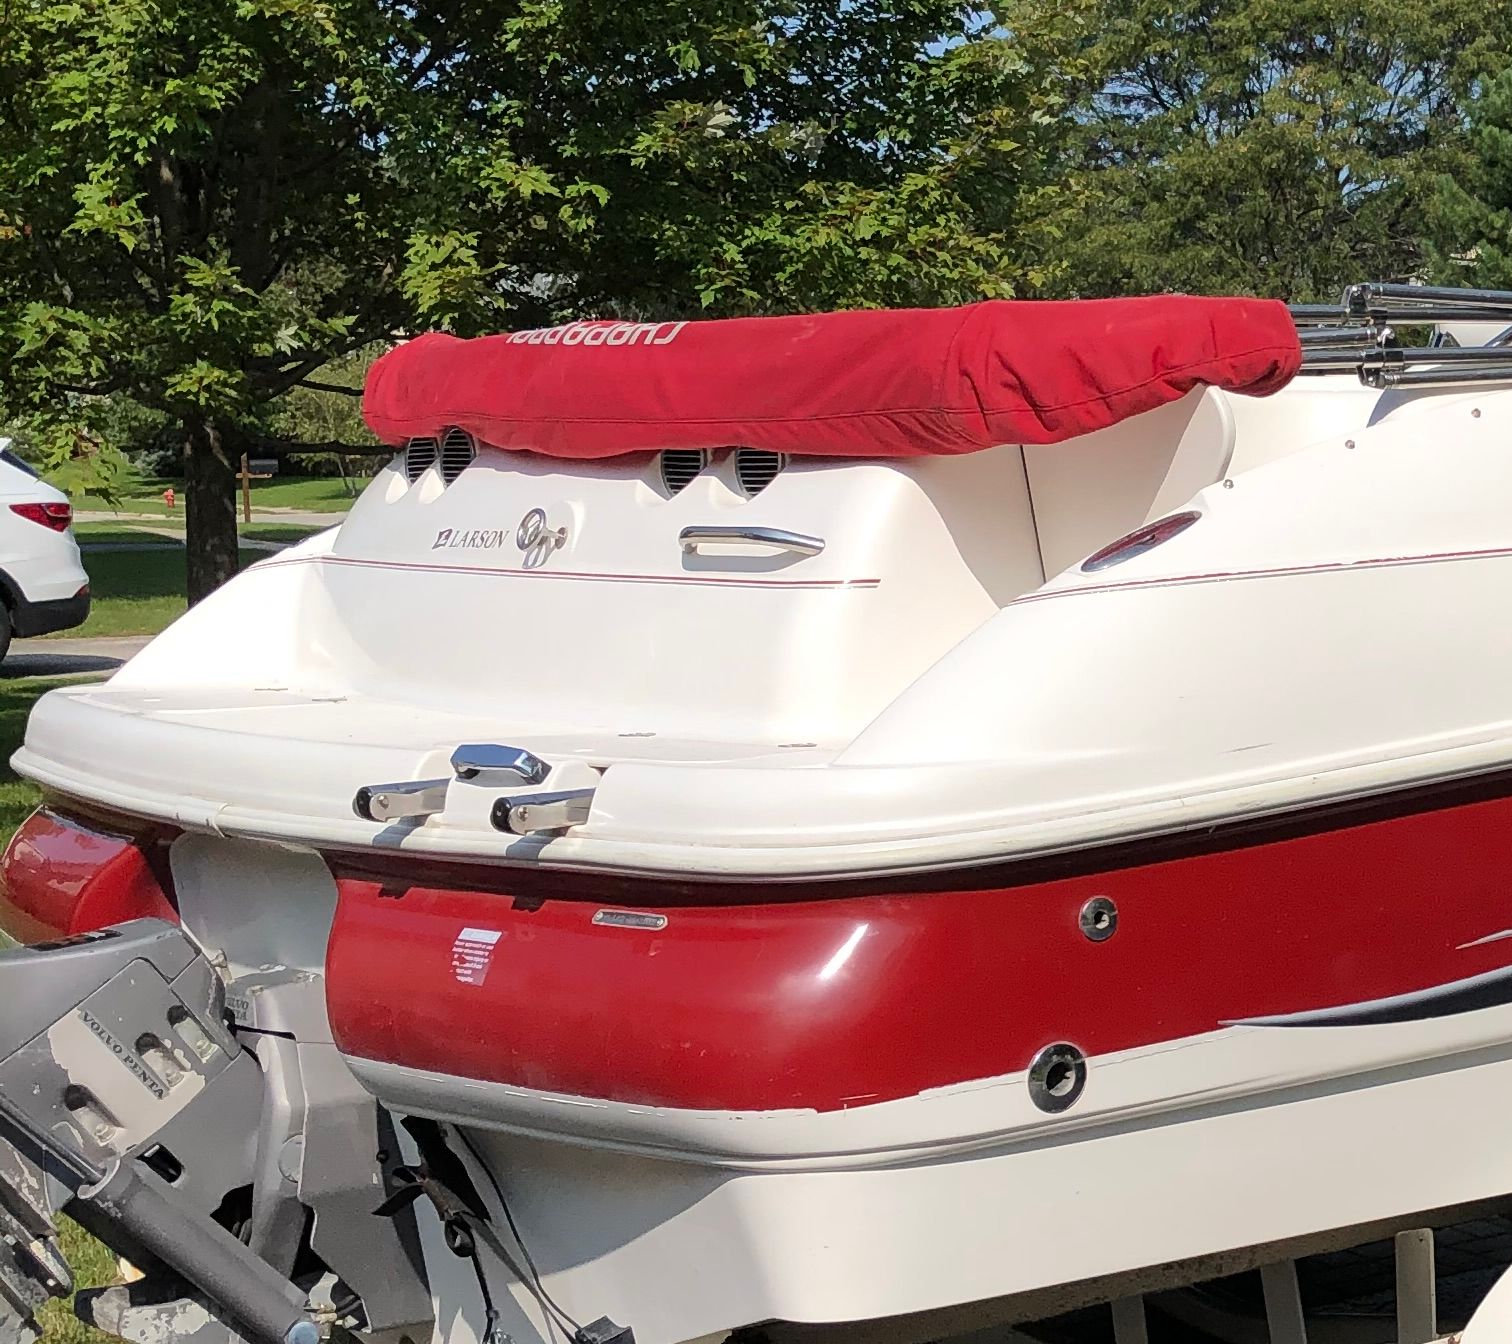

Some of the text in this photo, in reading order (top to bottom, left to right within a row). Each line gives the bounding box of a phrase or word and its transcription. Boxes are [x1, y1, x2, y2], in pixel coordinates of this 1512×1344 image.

[448, 529, 511, 549] LARSON
[81, 1009, 165, 1100] VOLVO PENTA
